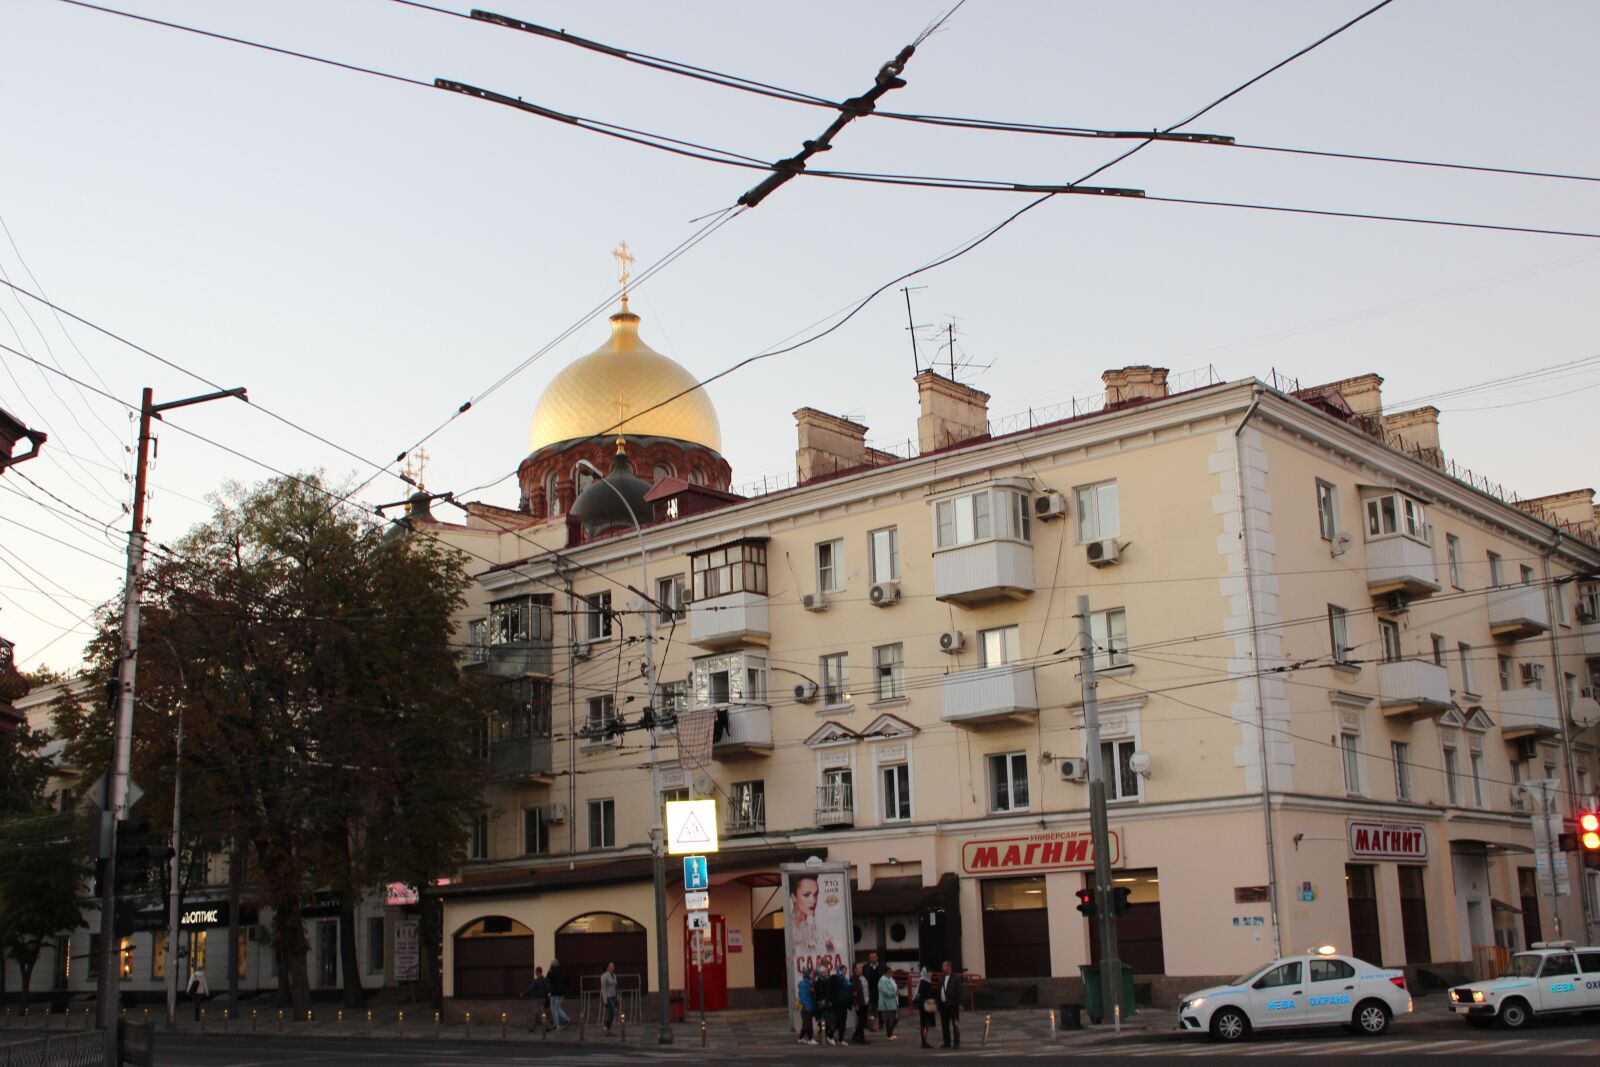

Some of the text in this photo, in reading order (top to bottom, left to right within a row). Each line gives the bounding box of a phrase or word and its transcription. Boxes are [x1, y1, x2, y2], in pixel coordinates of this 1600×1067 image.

[1029, 831, 1078, 841] УНИВЕРСАМ
[1355, 829, 1421, 852] МАГНИТ
[1308, 994, 1351, 1007] ОХРАНА
